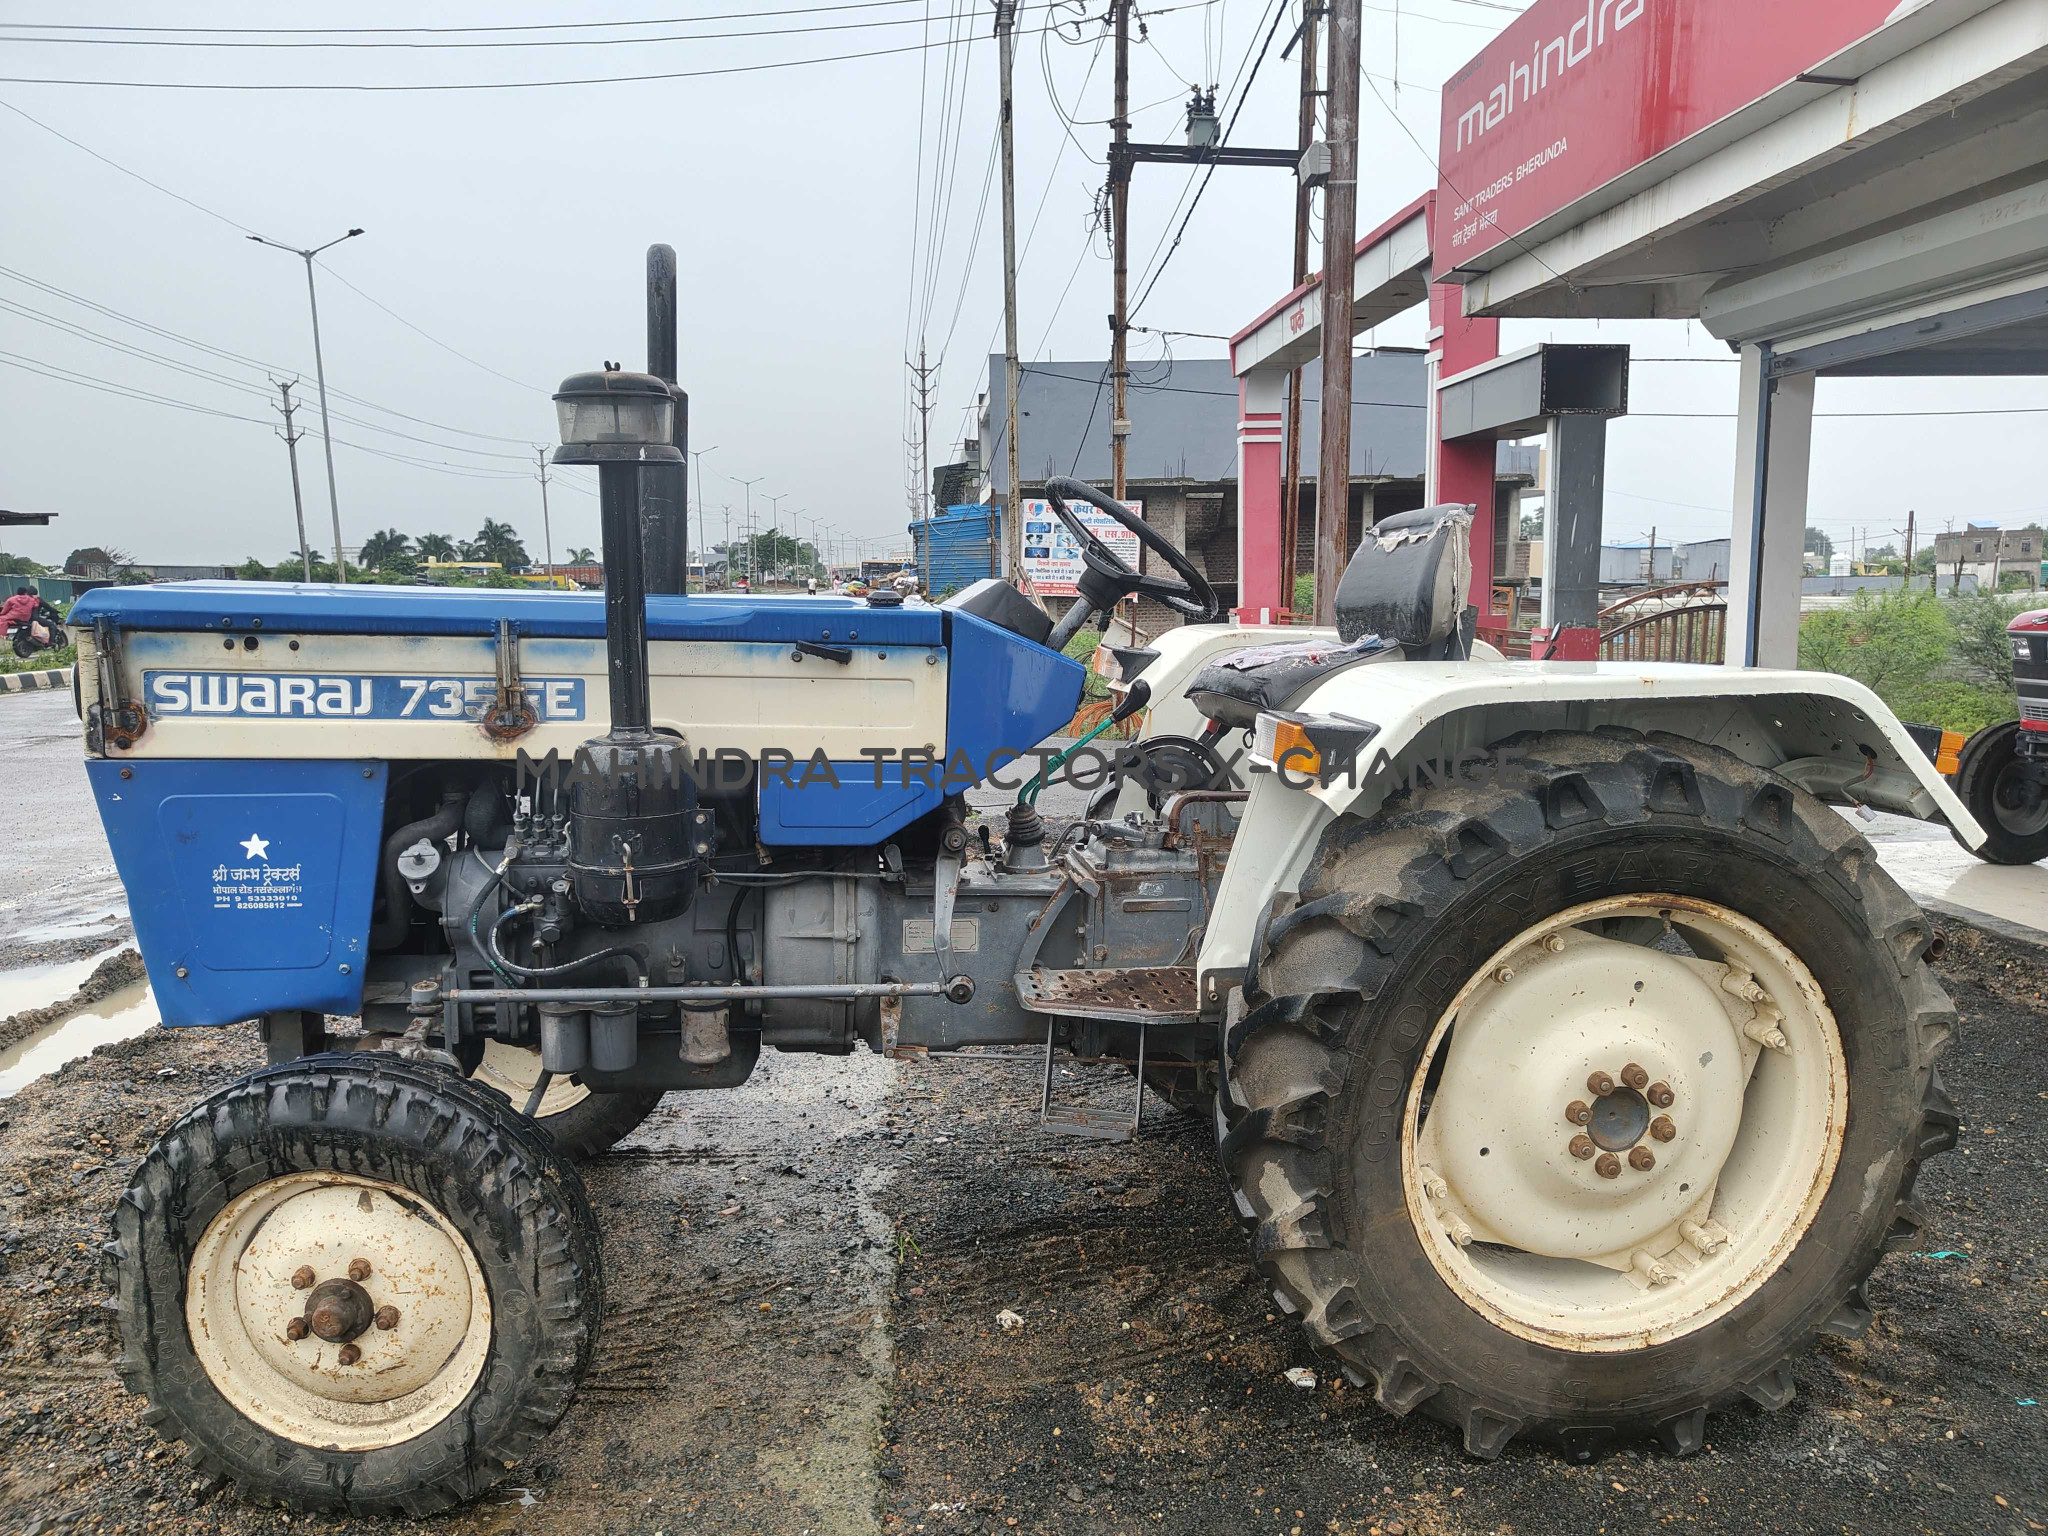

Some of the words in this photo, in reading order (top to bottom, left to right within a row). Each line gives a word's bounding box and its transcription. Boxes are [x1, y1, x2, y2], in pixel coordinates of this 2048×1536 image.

[1457, 0, 1645, 153] mahindra
[1453, 197, 1474, 221] SANT
[1475, 171, 1513, 207] TRADERS
[1516, 136, 1567, 181] BHERUNDA
[1073, 502, 1094, 514] केयर
[400, 679, 501, 718] 735
[212, 864, 228, 882] श्री
[212, 884, 237, 894] भोपाल
[239, 884, 252, 894] रोड
[1361, 849, 1714, 1162] GOODYEAR
